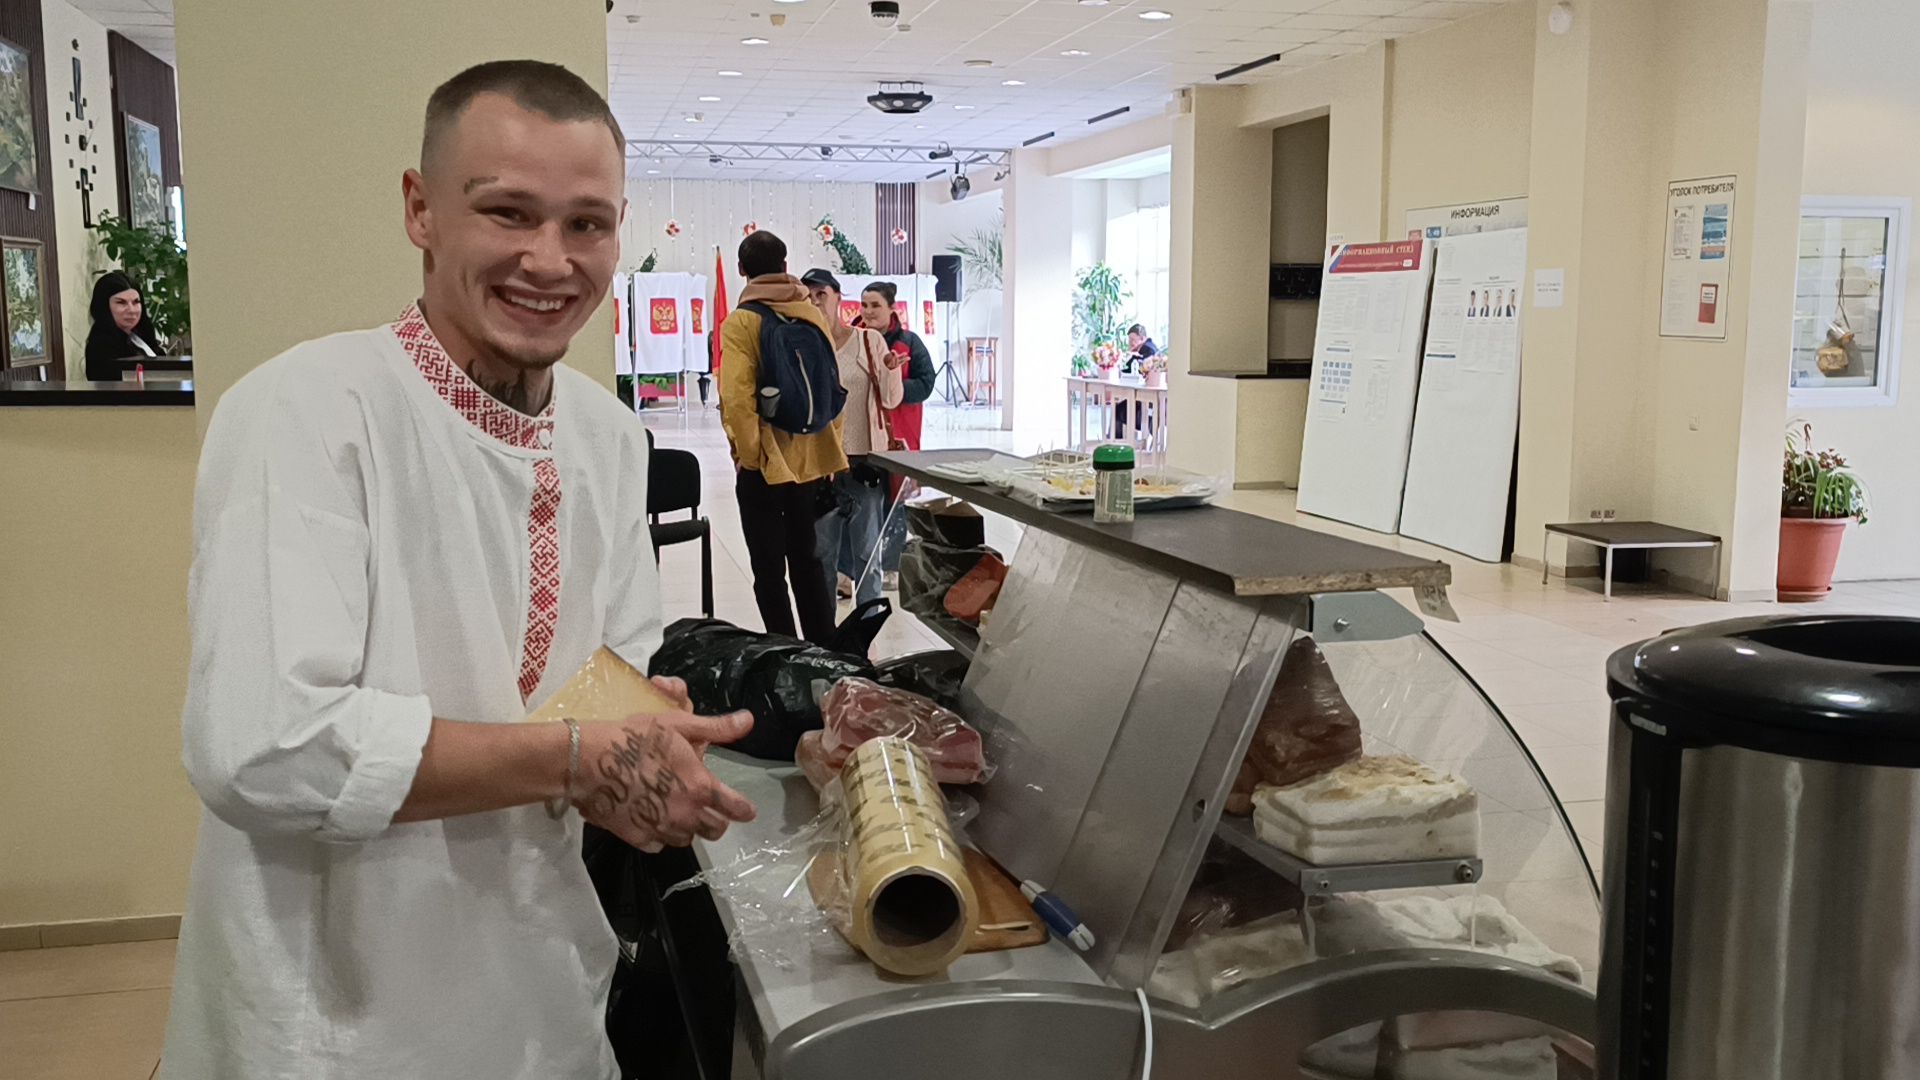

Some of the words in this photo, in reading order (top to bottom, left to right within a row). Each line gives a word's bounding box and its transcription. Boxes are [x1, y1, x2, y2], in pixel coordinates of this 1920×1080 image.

[1670, 186, 1692, 197] УГОЛОК
[1692, 182, 1734, 195] ПОТРЕБИТЕЛЯ
[1450, 205, 1500, 219] ИНФОРМАЦИЯ
